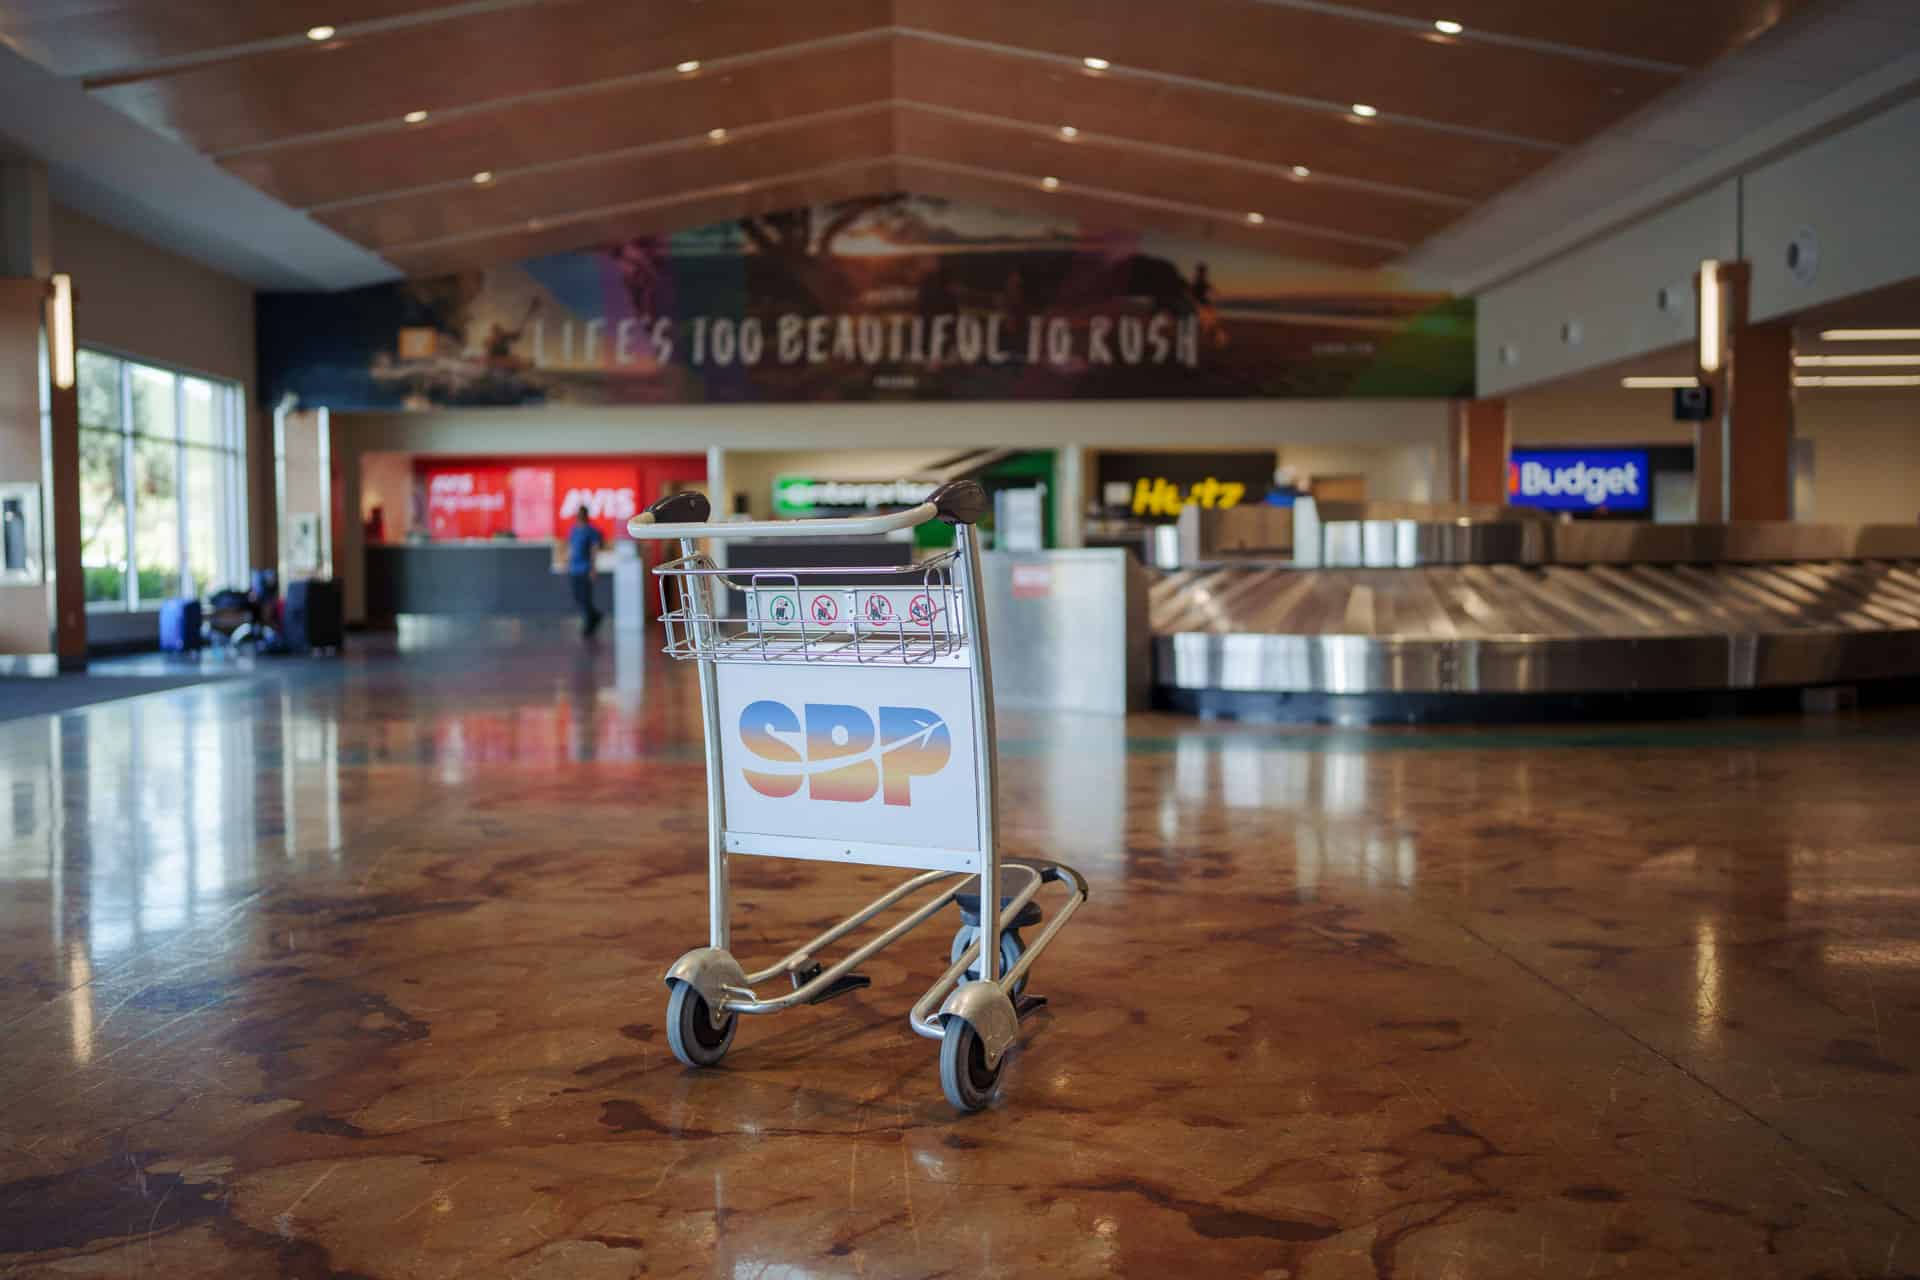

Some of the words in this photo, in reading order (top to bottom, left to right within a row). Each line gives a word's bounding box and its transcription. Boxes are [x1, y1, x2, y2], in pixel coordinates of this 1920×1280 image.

[531, 316, 673, 368] LIFE'S
[691, 316, 763, 363] TOO
[777, 312, 1009, 367] BEAUTIFUL
[1028, 316, 1072, 362] TO
[1088, 316, 1199, 367] RUSH
[559, 487, 636, 519] AVIS
[1520, 460, 1639, 504] Budget
[738, 699, 952, 807] SBP
